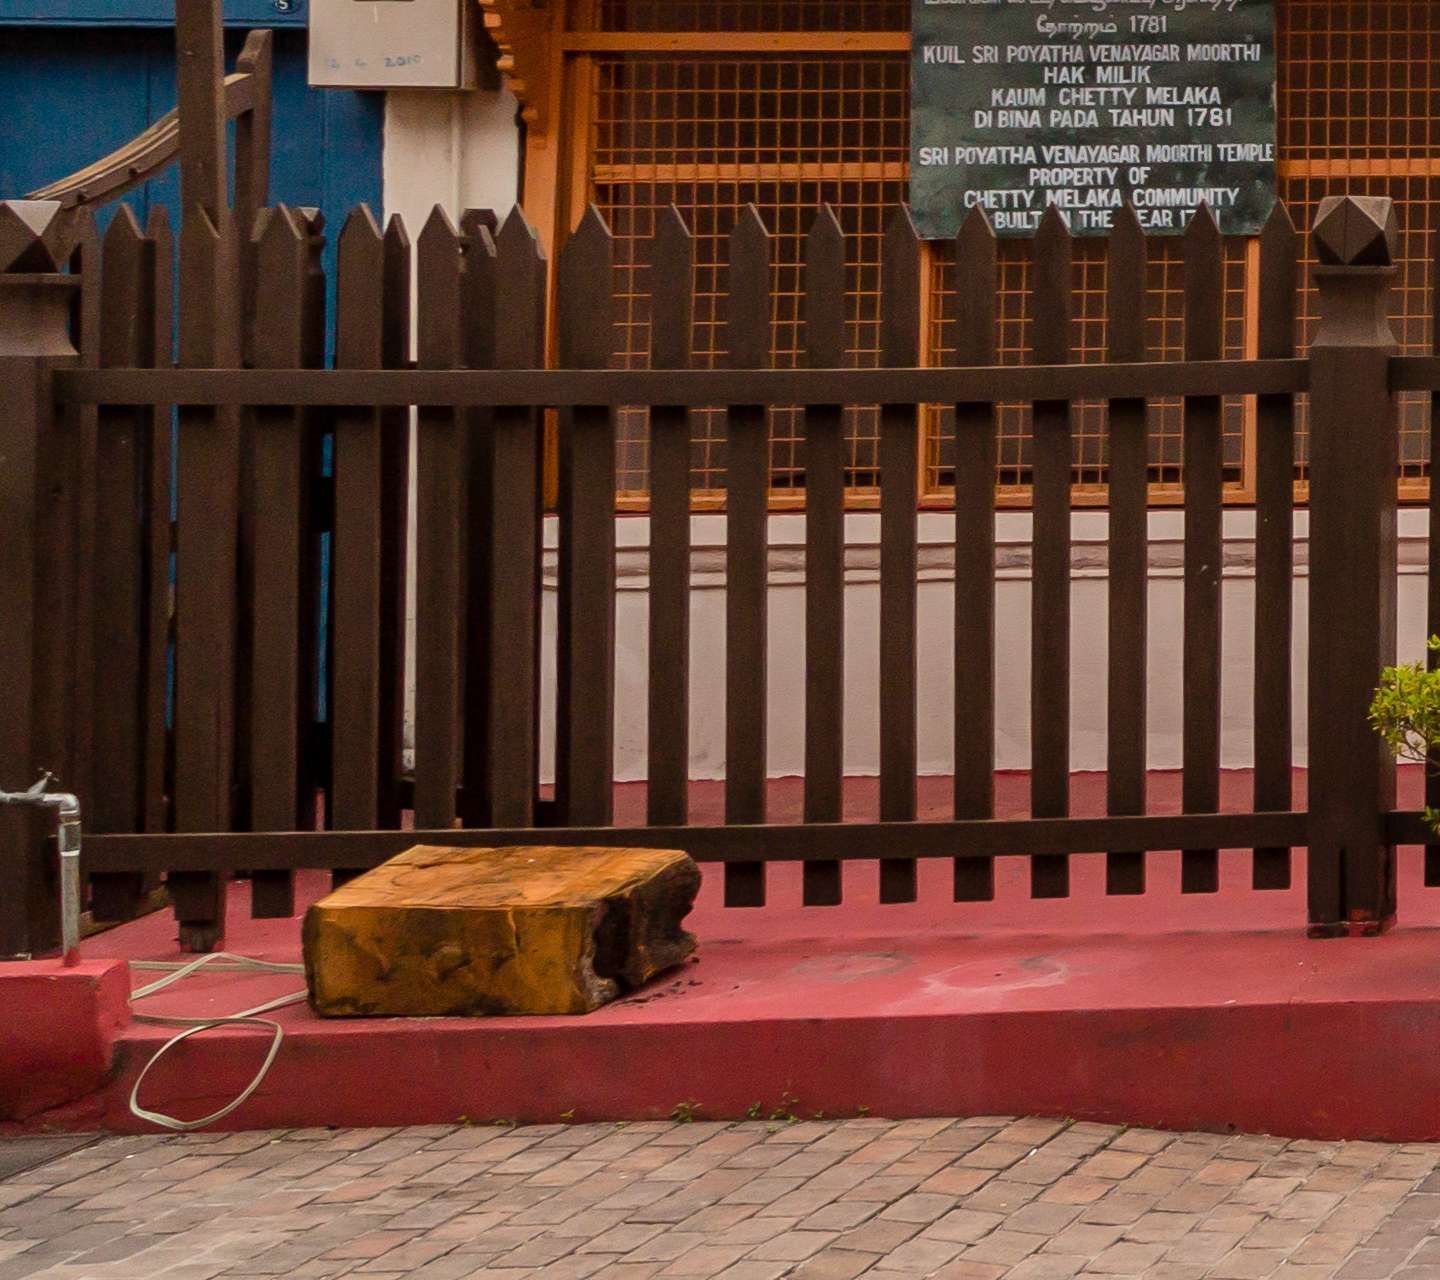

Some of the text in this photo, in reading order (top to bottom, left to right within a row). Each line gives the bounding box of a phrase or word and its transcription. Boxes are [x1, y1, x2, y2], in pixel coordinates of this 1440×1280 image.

[1130, 15, 1168, 34] 1781
[923, 43, 1261, 65] KUIL SRI POYATHA VENAYAGAR MOORTHI
[1043, 65, 1151, 85] HAK MILIK
[991, 87, 1222, 107] KAUM CHETTY MELAKA
[1050, 109, 1099, 128] PADA
[1108, 109, 1175, 128] TAHUN
[1187, 108, 1232, 127] 1781
[919, 143, 1275, 166] SRI POYATHA VENAYAGAR MOORTHI TEMPLE
[1029, 166, 1151, 186] PROPERTY OF
[964, 188, 1240, 209] CHETTY MELAKA COMMUNITY
[994, 211, 1043, 229] BUILT
[1078, 210, 1114, 228] THE
[1128, 209, 1173, 228] EAR
